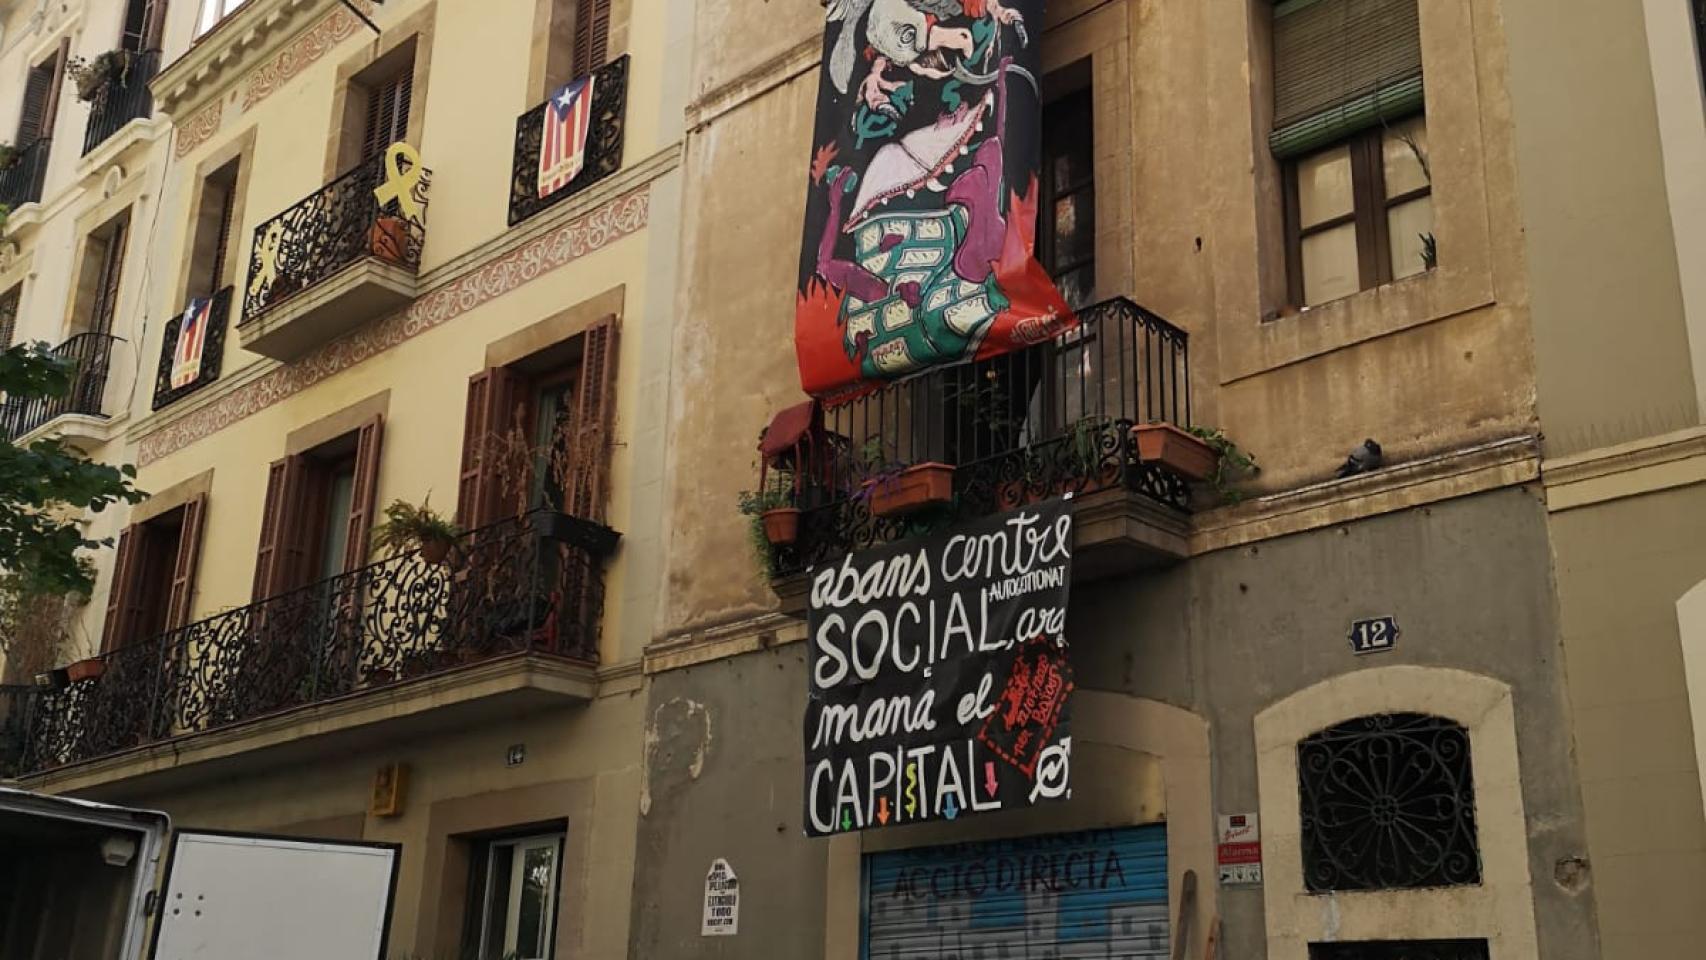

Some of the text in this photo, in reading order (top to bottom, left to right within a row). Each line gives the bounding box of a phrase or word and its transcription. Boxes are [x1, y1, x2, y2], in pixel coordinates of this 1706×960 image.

[811, 511, 1070, 609] abans centre
[1016, 607, 1066, 642] ara
[1359, 621, 1388, 648] 12
[811, 689, 937, 750] mana
[956, 672, 995, 724] el
[810, 739, 1001, 834] CAPITAL
[995, 849, 1126, 891] DIRECTA
